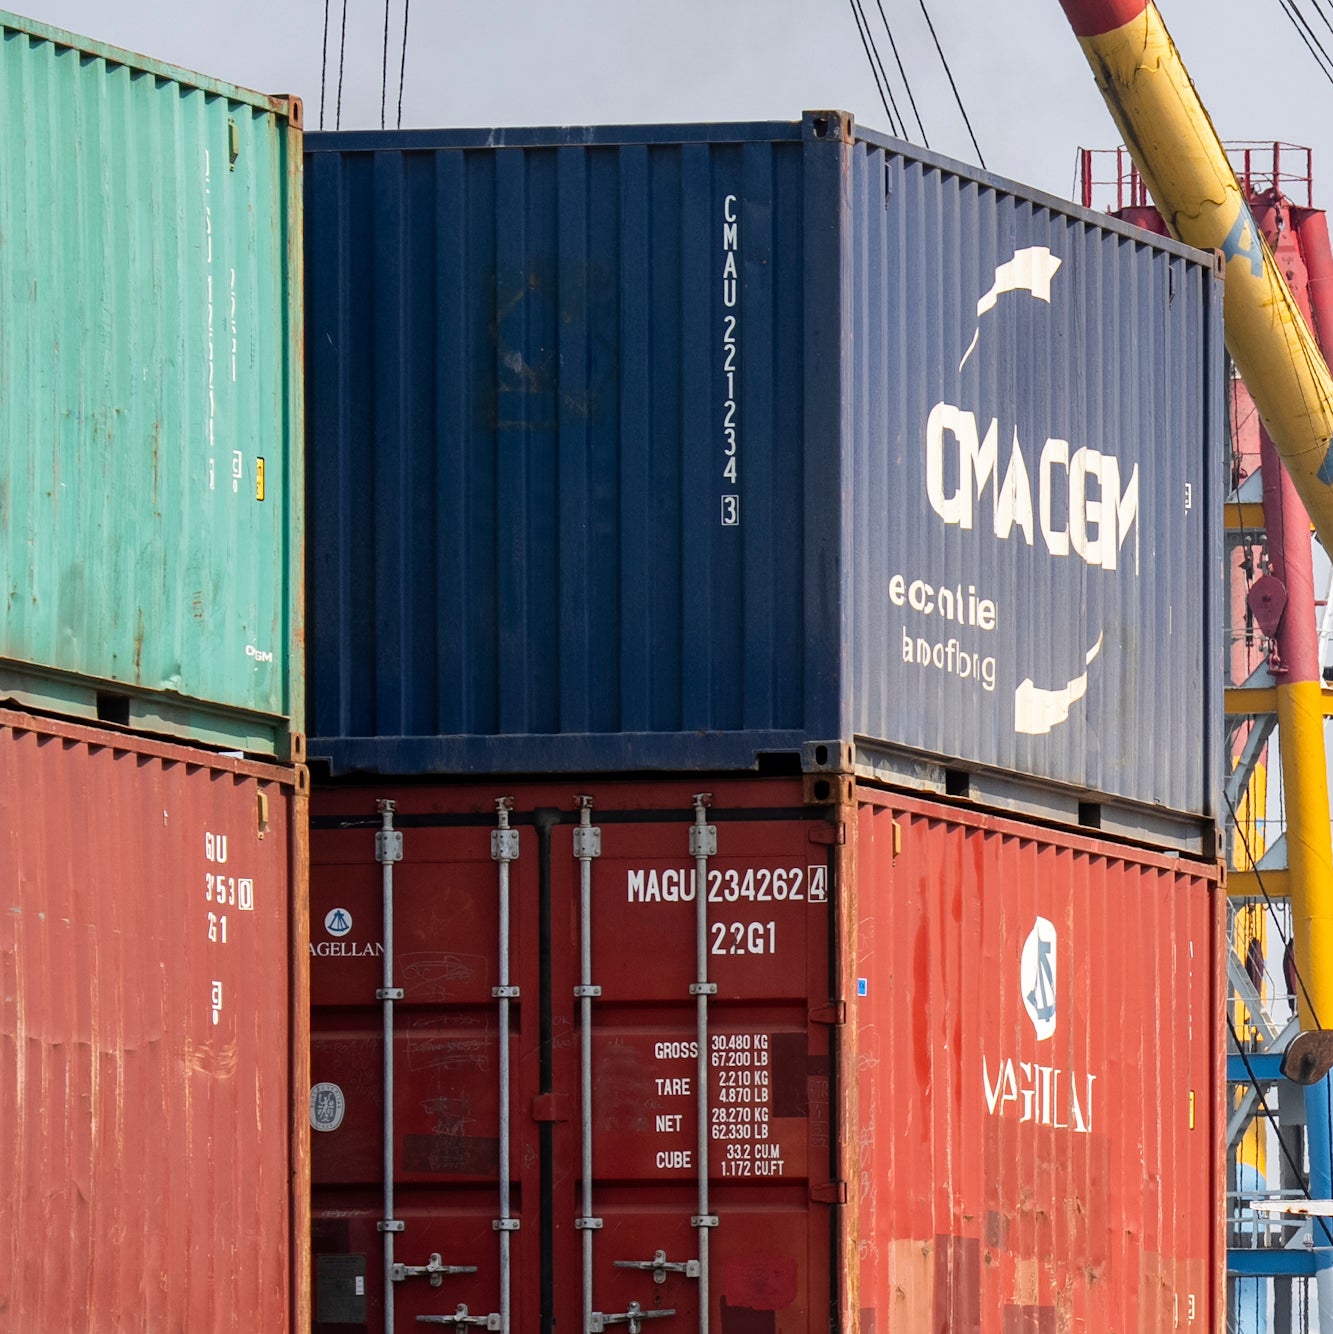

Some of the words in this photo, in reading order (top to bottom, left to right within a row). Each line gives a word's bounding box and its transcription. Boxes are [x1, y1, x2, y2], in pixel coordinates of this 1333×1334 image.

[723, 195, 737, 306] CMAU
[724, 316, 736, 483] 221234
[722, 495, 739, 525] 3
[627, 869, 696, 902] MAGU
[708, 868, 803, 902] 234262
[808, 865, 827, 902] 4
[712, 922, 774, 954] 22G1
[712, 1035, 750, 1049] 30.480
[754, 1035, 767, 1049] KG
[655, 1042, 698, 1060] GROSS
[712, 1052, 750, 1066] 67.200
[754, 1052, 767, 1065] LB
[720, 1071, 750, 1086] 2.210
[755, 1071, 768, 1085] KG
[655, 1079, 690, 1095] TARE
[720, 1088, 750, 1102] 4.870
[755, 1088, 768, 1102] LB
[656, 1115, 682, 1131] NET
[713, 1108, 750, 1122] 28.270
[755, 1108, 768, 1121] KG
[713, 1124, 750, 1139] 62.330
[755, 1124, 768, 1138] LB
[727, 1145, 750, 1158] 33.2
[755, 1144, 779, 1158] CU.M
[657, 1151, 691, 1168] CUBE
[721, 1161, 750, 1175] 1.172
[755, 1161, 784, 1175] CU.FT
